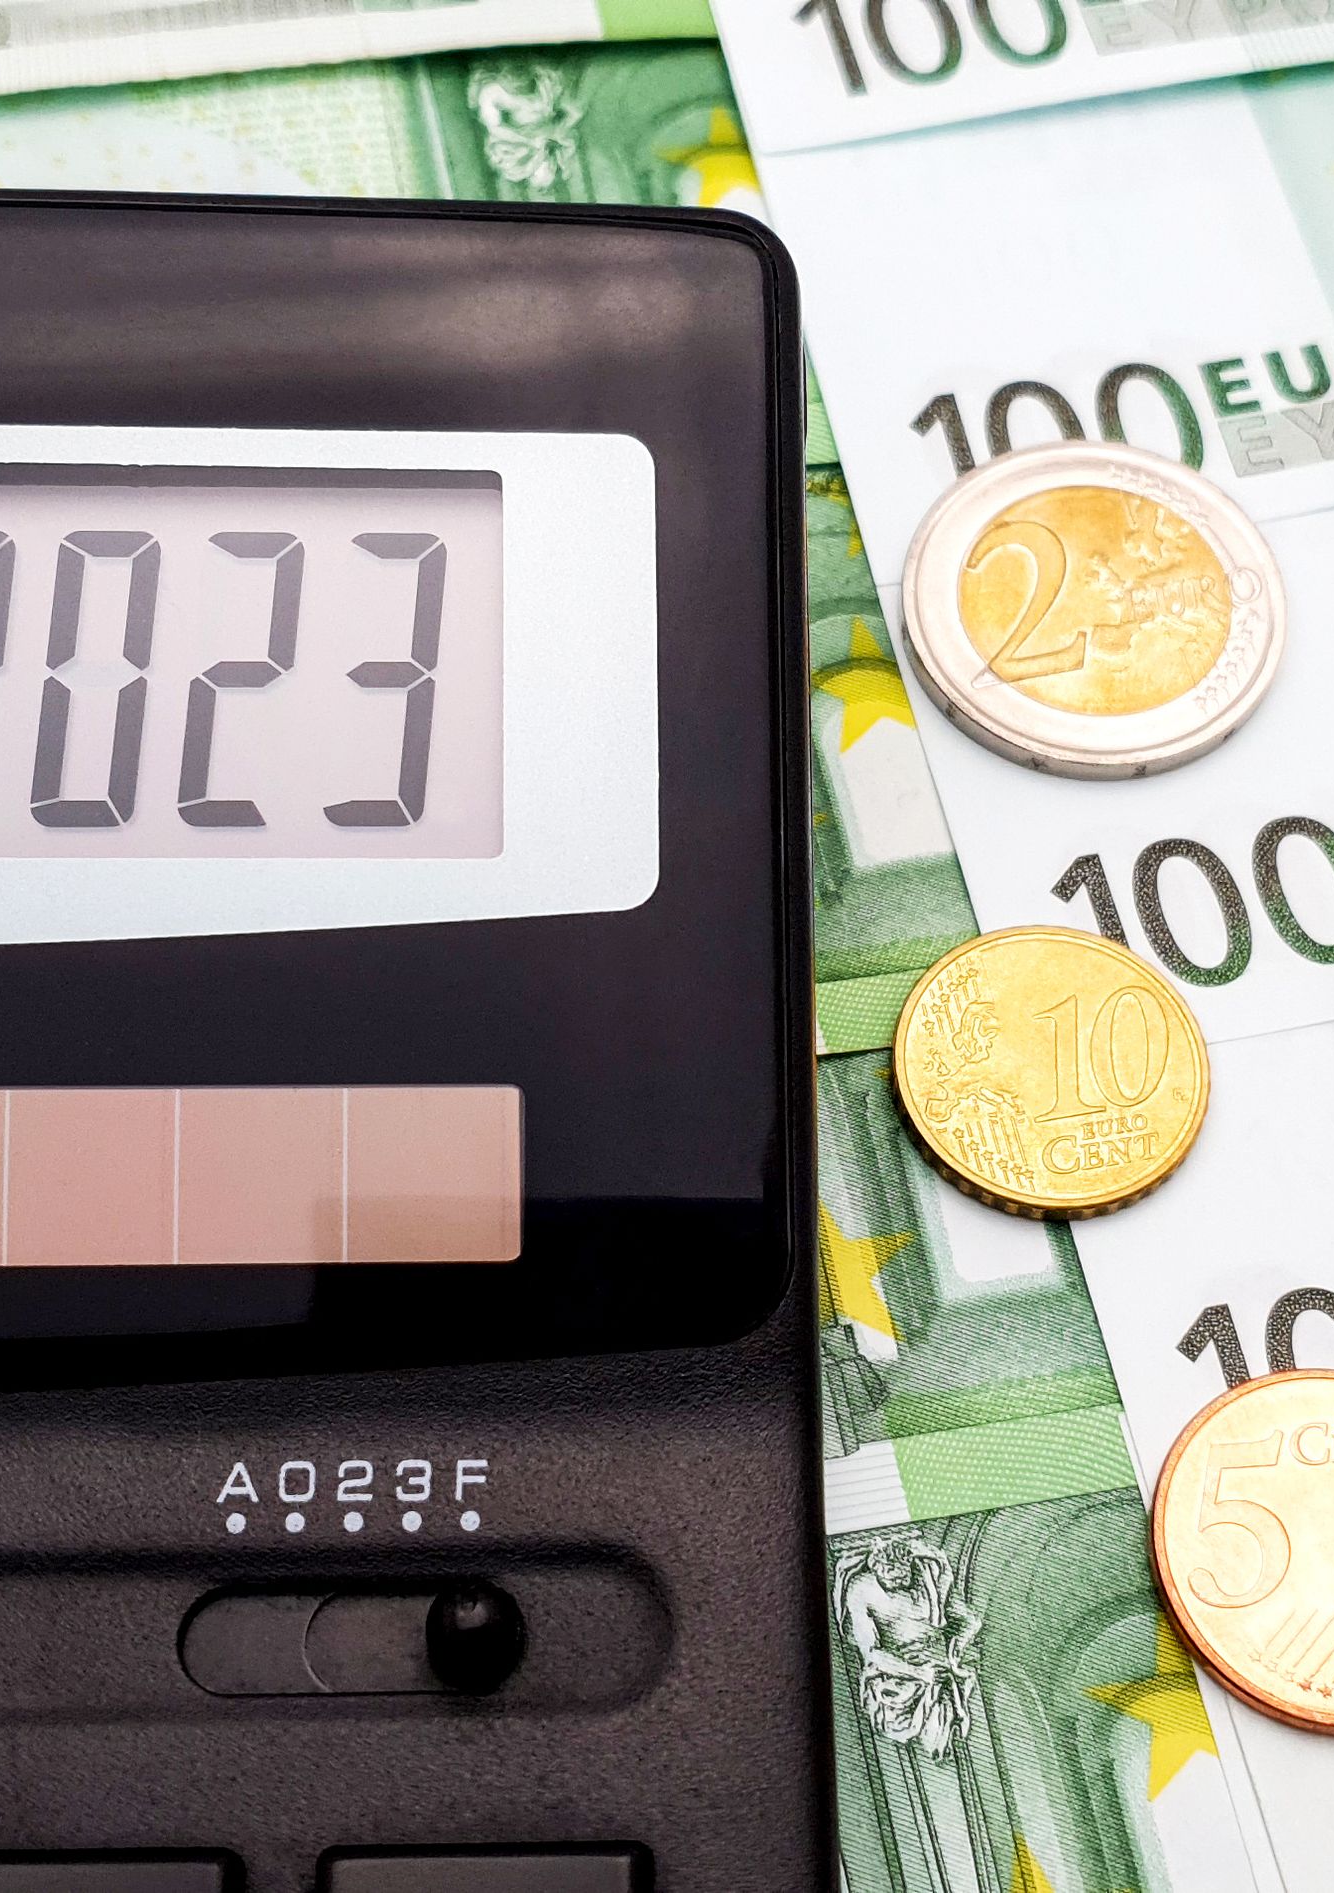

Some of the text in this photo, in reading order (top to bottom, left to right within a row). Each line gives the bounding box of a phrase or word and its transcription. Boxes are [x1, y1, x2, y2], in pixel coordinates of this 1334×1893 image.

[793, 0, 1067, 96] 100
[964, 520, 1087, 688] 2
[1032, 985, 1170, 1123] 10
[1041, 1132, 1160, 1175] CENT
[1081, 1114, 1148, 1140] EURO
[1187, 1429, 1292, 1609] 5
